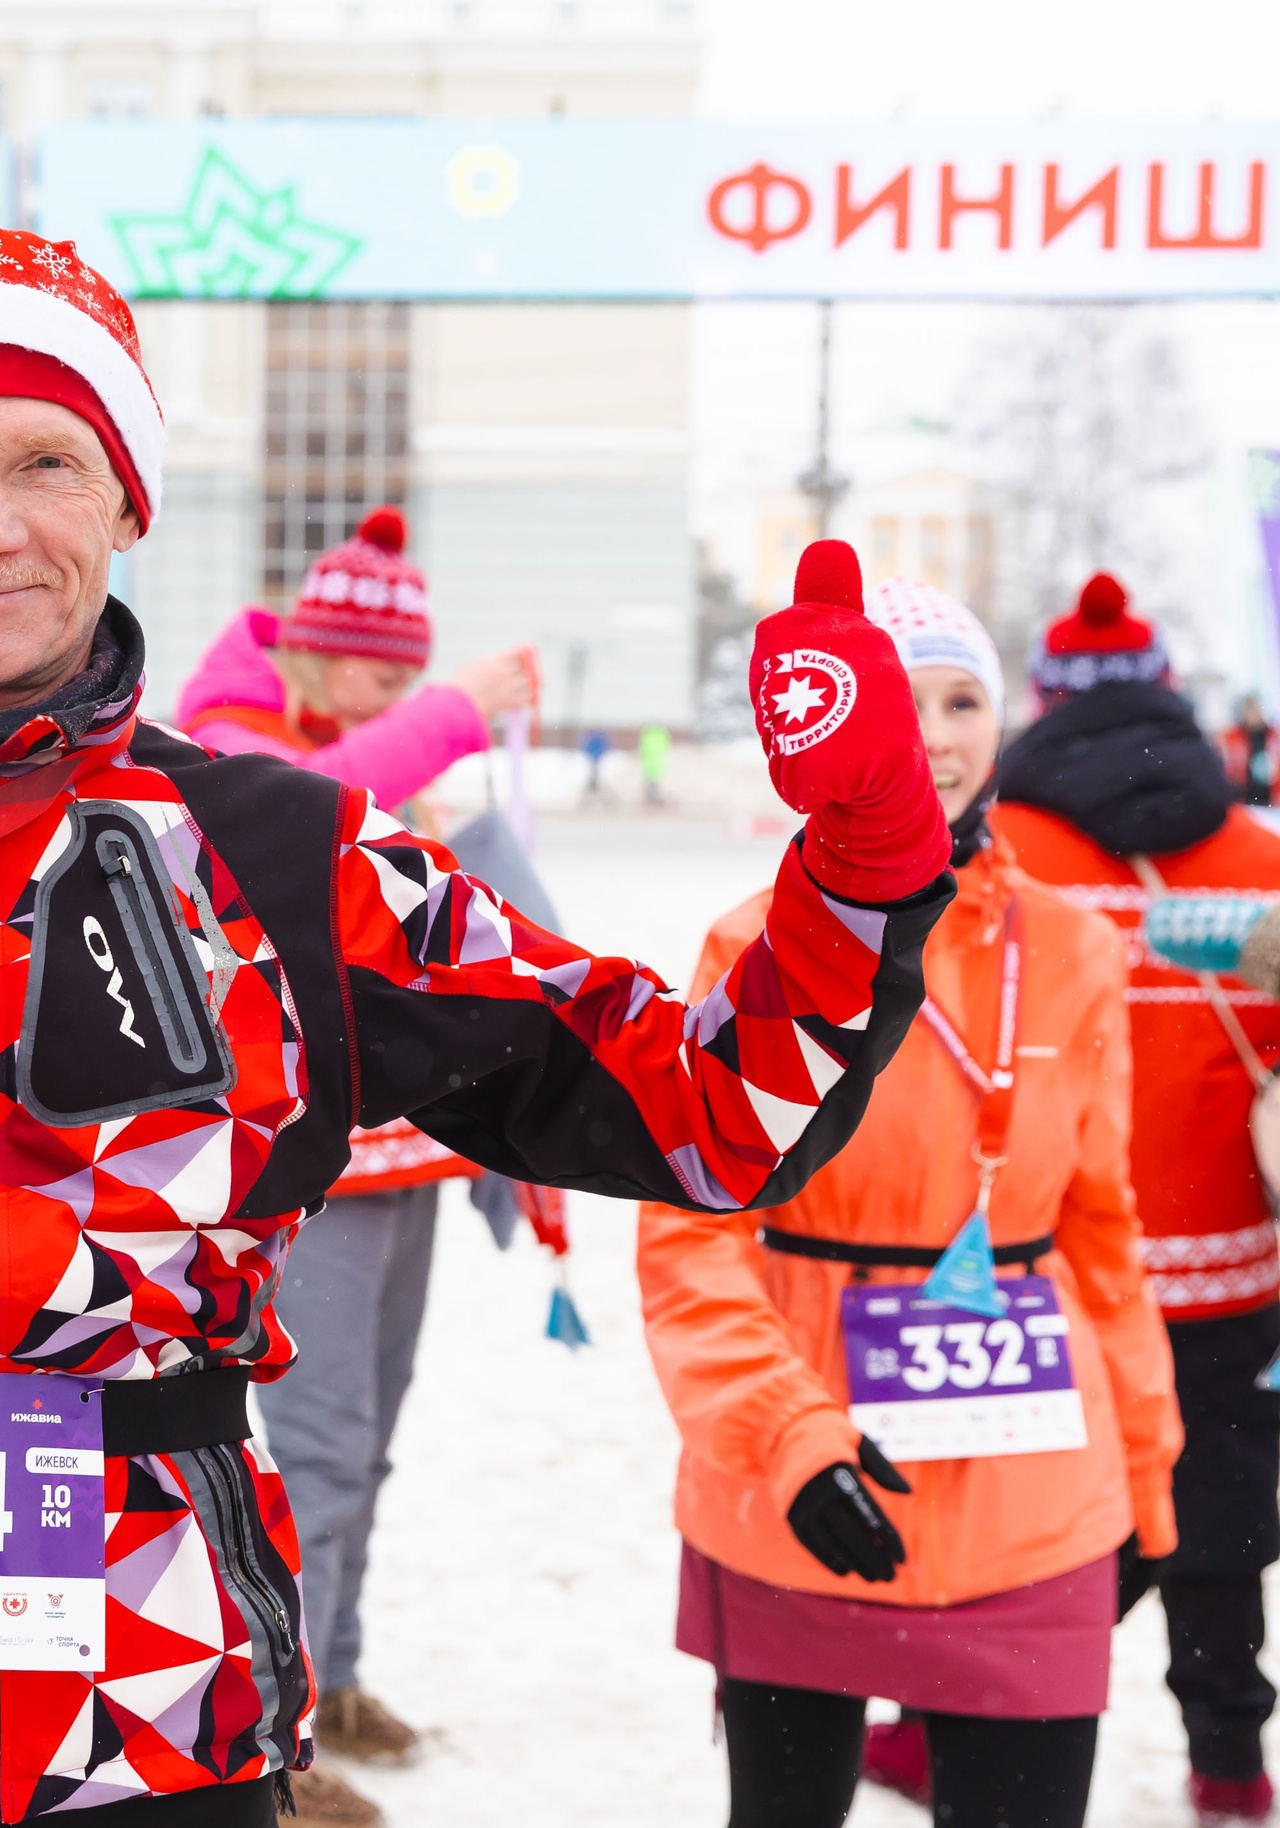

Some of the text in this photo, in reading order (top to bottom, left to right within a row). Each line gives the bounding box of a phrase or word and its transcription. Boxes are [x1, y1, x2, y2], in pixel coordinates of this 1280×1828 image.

[708, 162, 1266, 254] ФИНИШ
[789, 653, 852, 750] ТЕРРИТОРИЯ СПОРТА
[899, 1319, 1032, 1392] 332
[35, 1454, 79, 1470] ИЖЕВСК
[41, 1484, 72, 1508] 10
[41, 1511, 72, 1528] КМ
